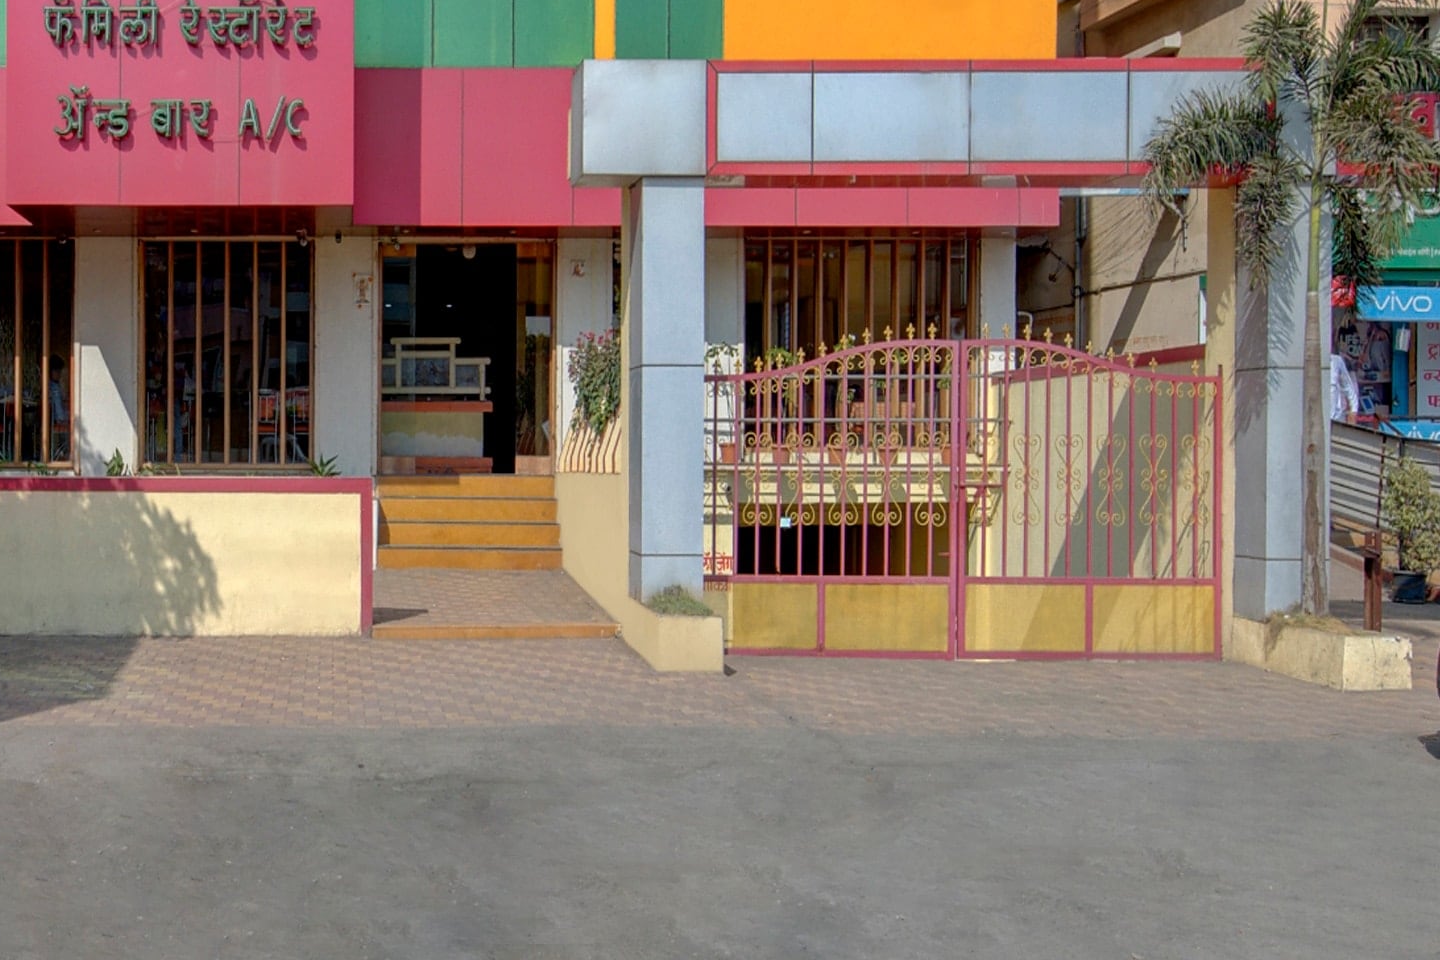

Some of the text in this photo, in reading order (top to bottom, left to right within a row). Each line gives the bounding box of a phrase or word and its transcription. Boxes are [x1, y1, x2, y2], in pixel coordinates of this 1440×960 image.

[150, 98, 213, 138] बार
[238, 95, 305, 142] A/C
[1373, 290, 1432, 313] vivo
